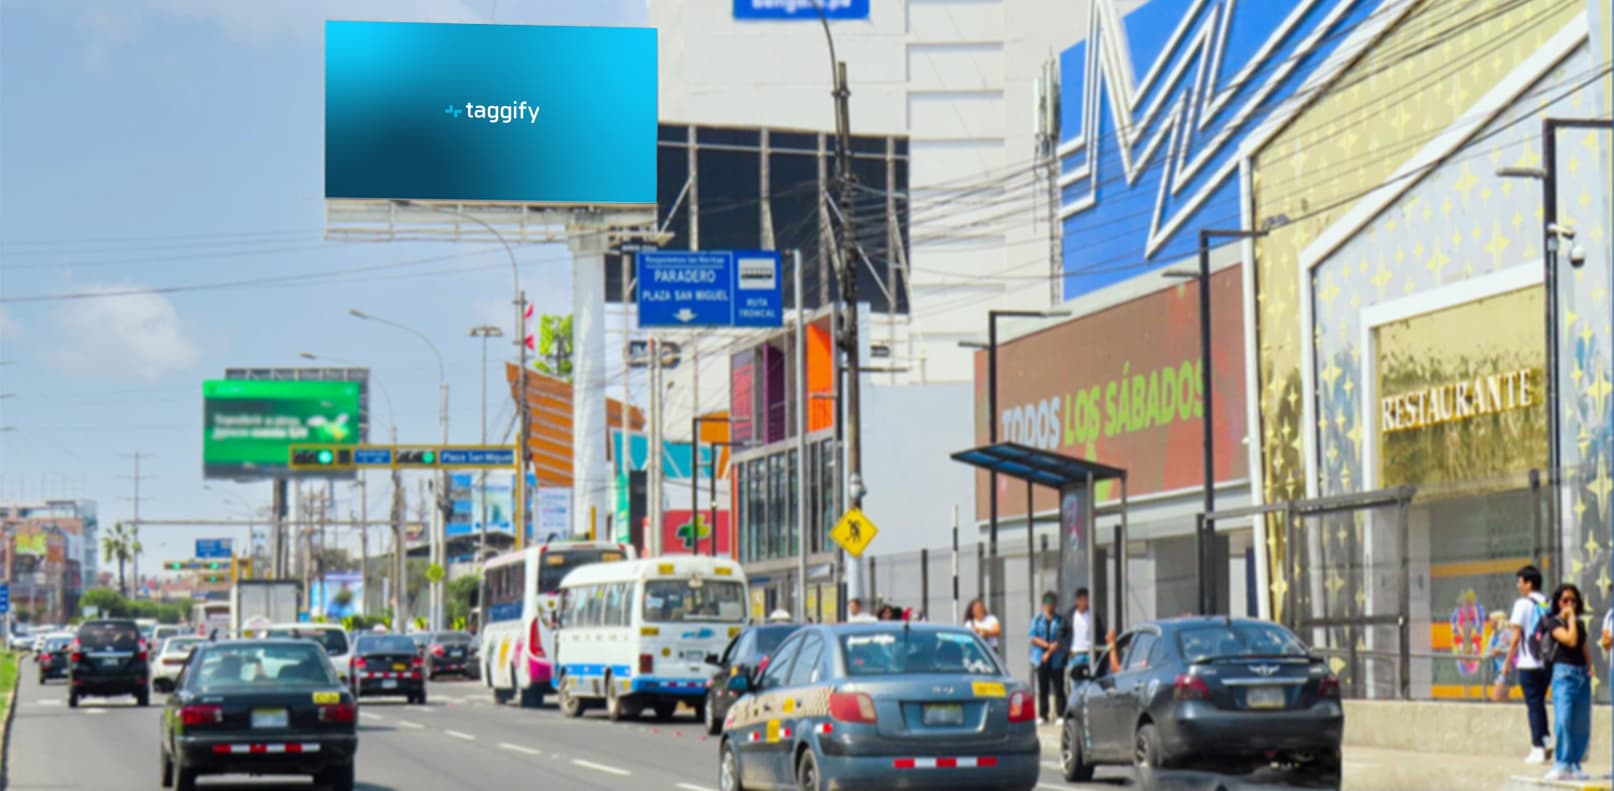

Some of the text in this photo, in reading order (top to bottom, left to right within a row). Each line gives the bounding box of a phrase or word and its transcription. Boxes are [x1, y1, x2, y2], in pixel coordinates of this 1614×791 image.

[465, 100, 540, 124] taggify
[654, 269, 717, 283] PARADERO
[642, 290, 729, 301] PLAZA SAN MIGUEL
[746, 298, 768, 307] RUTA
[738, 309, 776, 318] TRONCAL
[1381, 368, 1533, 432] RESTAURANTE
[1001, 396, 1061, 449] TODOS
[1064, 385, 1101, 447] LOS
[442, 453, 466, 462] Plaza
